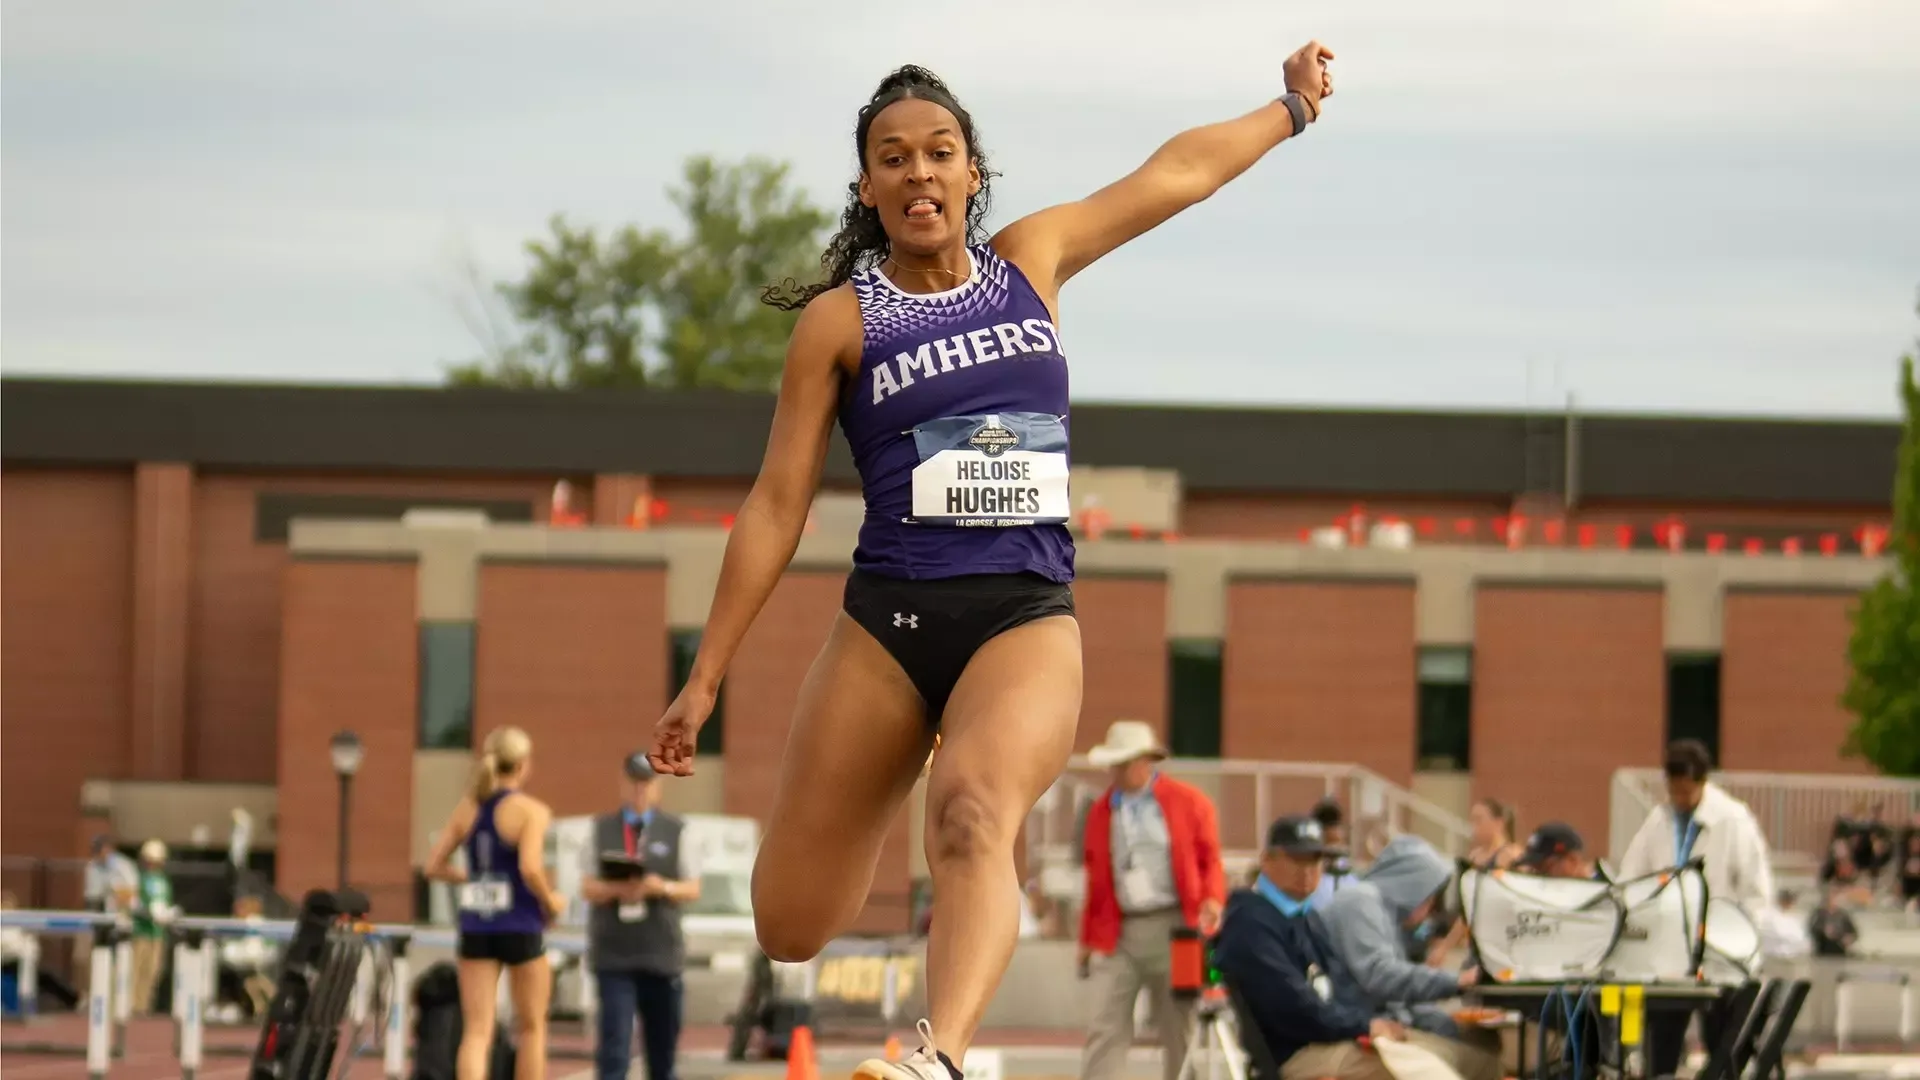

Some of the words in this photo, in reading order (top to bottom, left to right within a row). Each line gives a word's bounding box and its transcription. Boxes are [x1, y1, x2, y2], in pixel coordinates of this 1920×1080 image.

[957, 460, 1031, 480] HELOISE
[946, 487, 1040, 513] HUGHES
[956, 519, 964, 527] LA
[965, 519, 995, 527] CROSSE,
